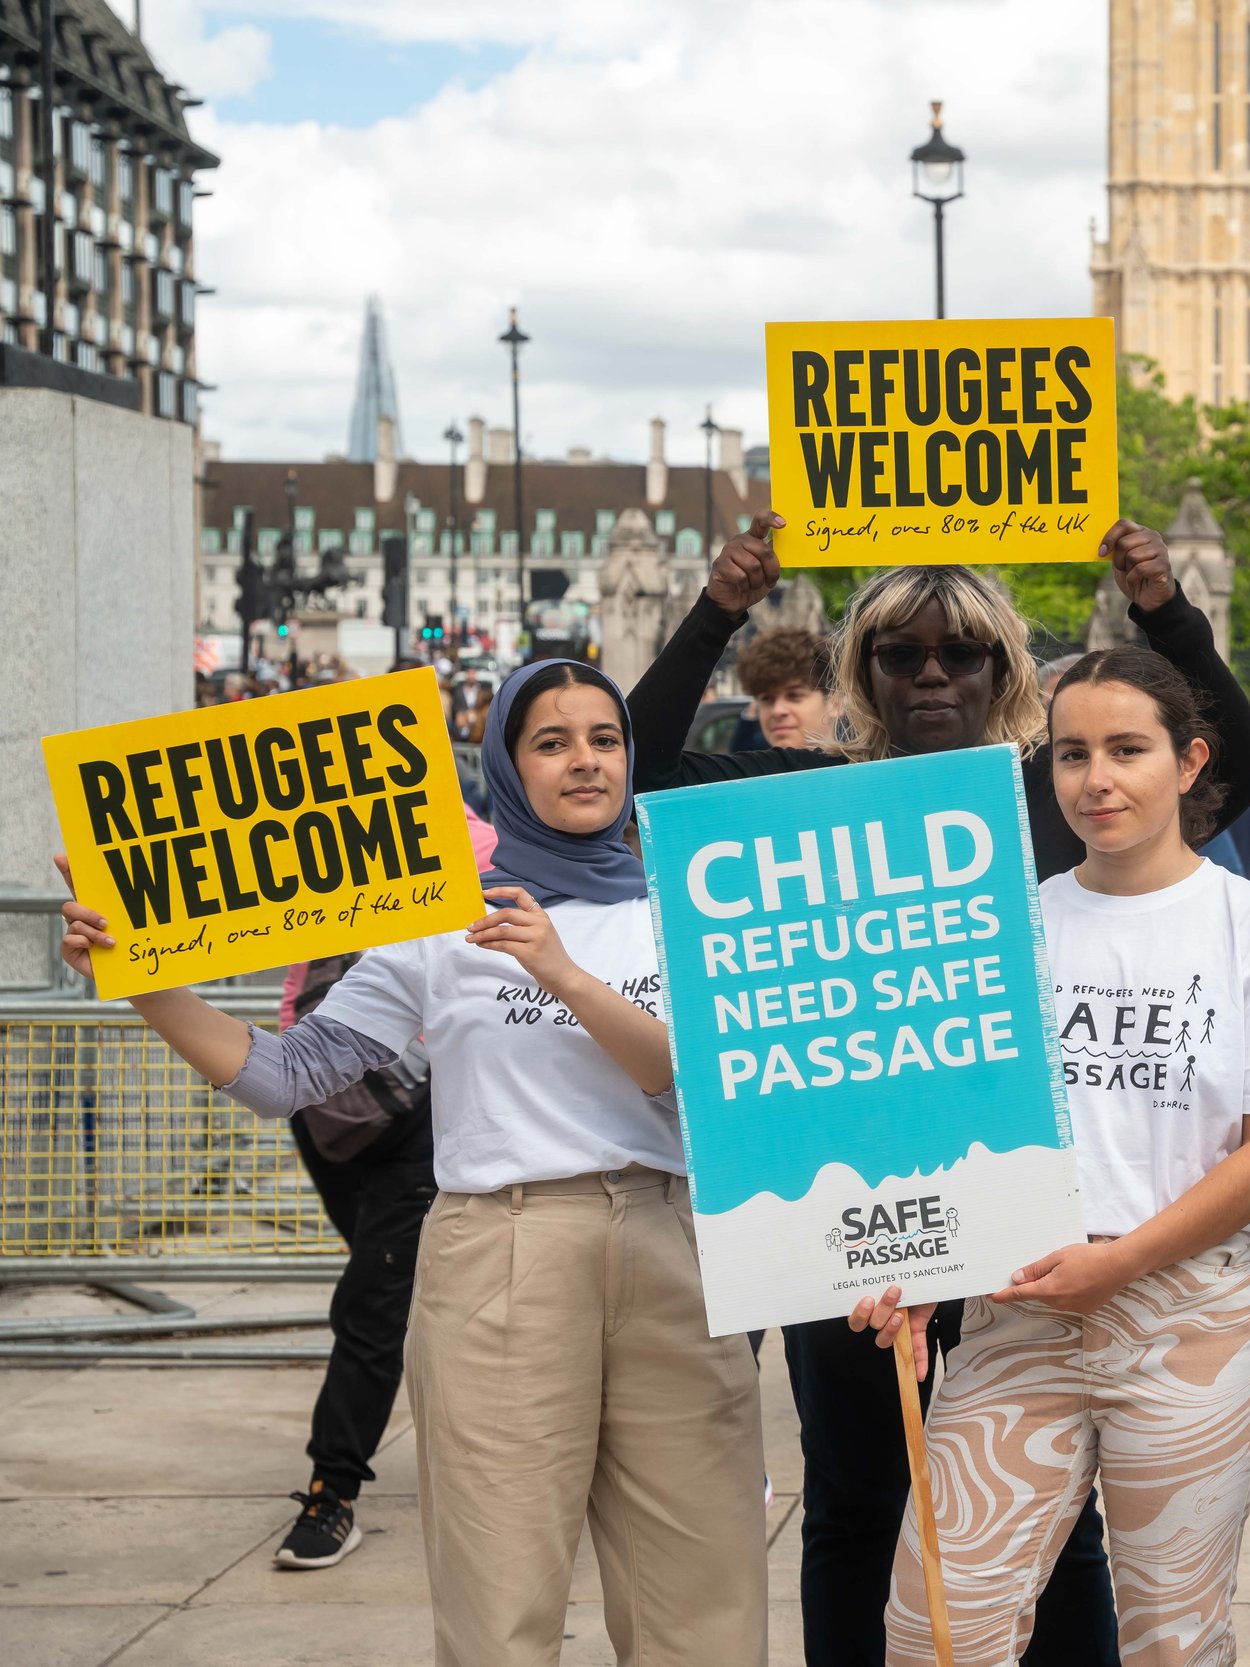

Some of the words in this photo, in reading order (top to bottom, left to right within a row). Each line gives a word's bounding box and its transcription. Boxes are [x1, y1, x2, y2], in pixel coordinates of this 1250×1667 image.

[792, 346, 1092, 427] REFUGEES
[800, 429, 1087, 508] WELCOME
[892, 526, 931, 535] over
[941, 514, 979, 533] 80%
[990, 511, 1016, 541] of
[1020, 516, 1048, 533] the
[1057, 513, 1089, 534] UK
[79, 704, 427, 845] REFUGEES
[103, 790, 441, 929] WELCOME
[687, 810, 993, 918] CHILD
[228, 926, 271, 943] over
[283, 909, 326, 930] 80%
[338, 899, 363, 927] of
[370, 892, 403, 914] the
[412, 881, 446, 906] UK
[702, 895, 1000, 977] REFUGEES
[621, 973, 661, 998] HAS
[714, 978, 857, 1033] NEED
[873, 955, 1005, 1010] SAFE
[1073, 985, 1133, 997] REFUGEES
[1142, 987, 1174, 998] NEED
[504, 1007, 542, 1025] NO
[1059, 1002, 1172, 1045] AFE
[719, 1011, 1018, 1100] PASSAGE
[1063, 1062, 1167, 1090] SSAGE
[842, 1195, 945, 1240] SAFE
[833, 1280, 860, 1290] LEGAL
[863, 1274, 895, 1286] ROUTES
[899, 1272, 910, 1280] TO
[913, 1264, 964, 1278] SANCTUARY
[847, 1237, 949, 1269] PASSAGE
